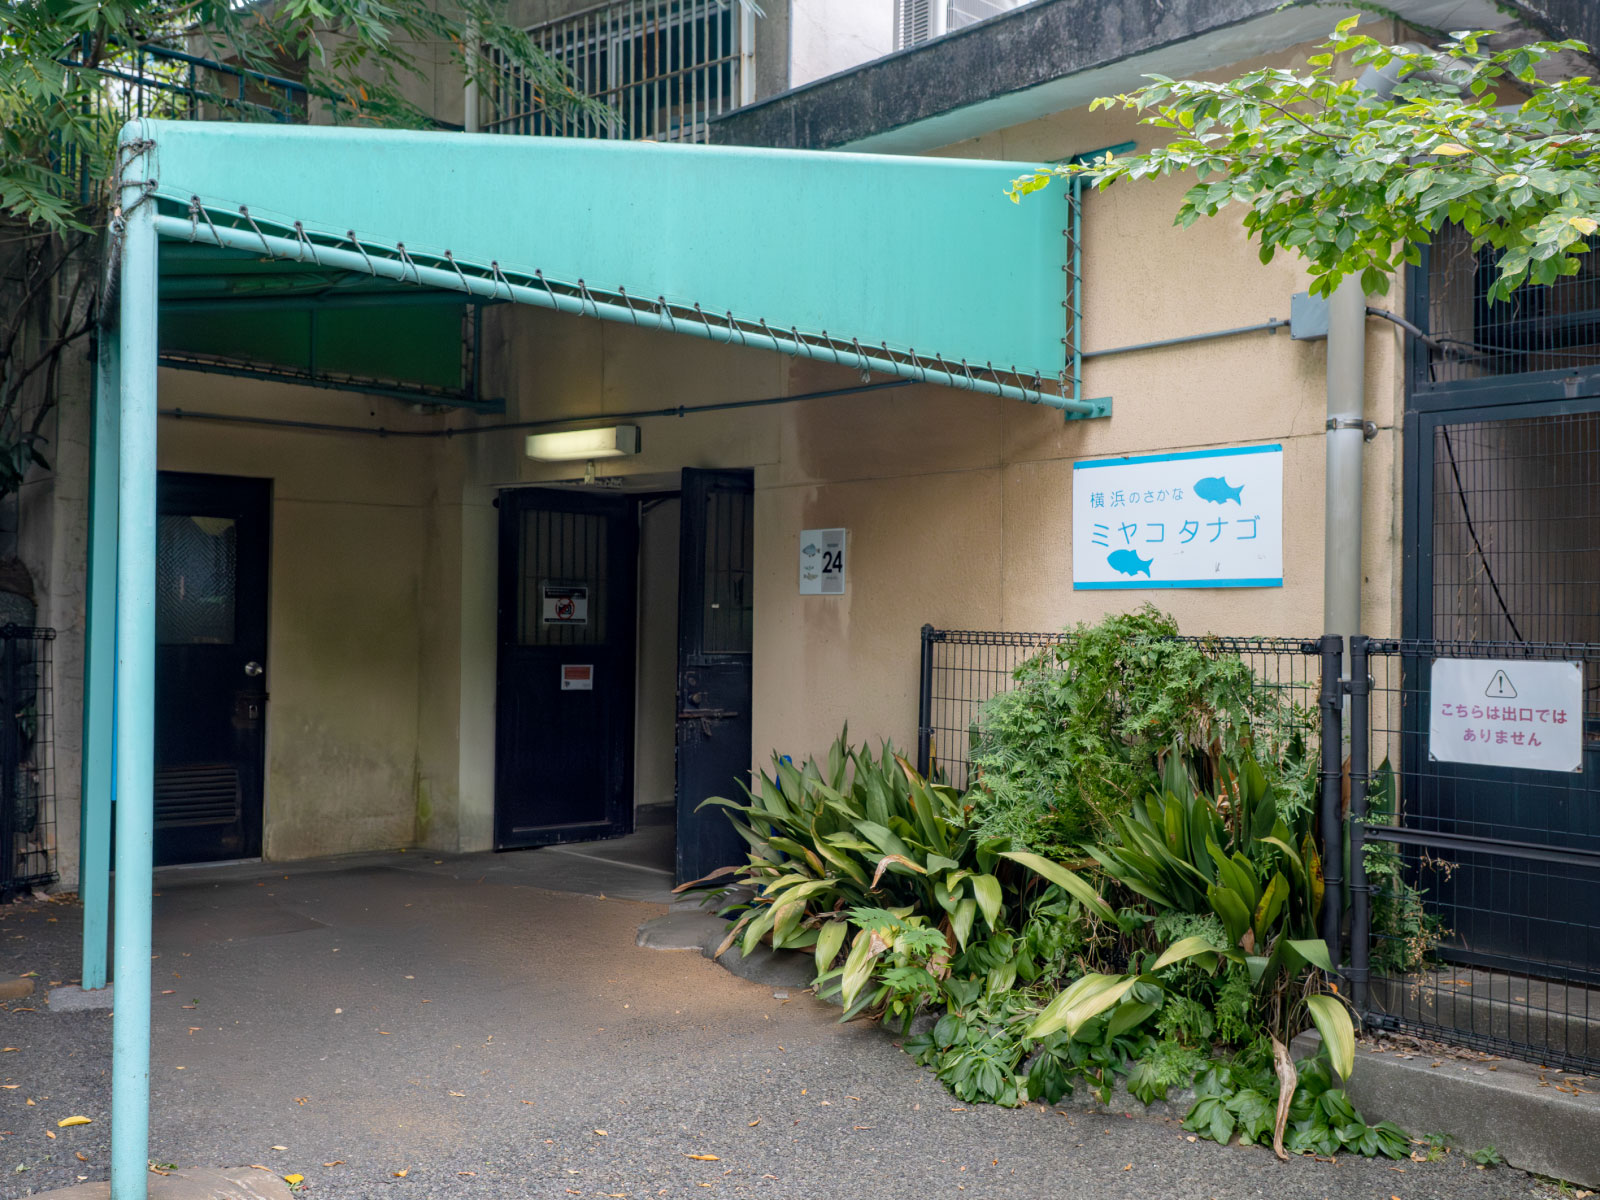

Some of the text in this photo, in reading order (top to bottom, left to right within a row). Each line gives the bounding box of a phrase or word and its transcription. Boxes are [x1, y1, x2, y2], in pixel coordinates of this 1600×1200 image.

[1090, 488, 1184, 508] 横浜のさかな
[822, 550, 843, 574] 24
[1441, 703, 1568, 724] こちらは出口では
[1463, 728, 1542, 747] ありません
